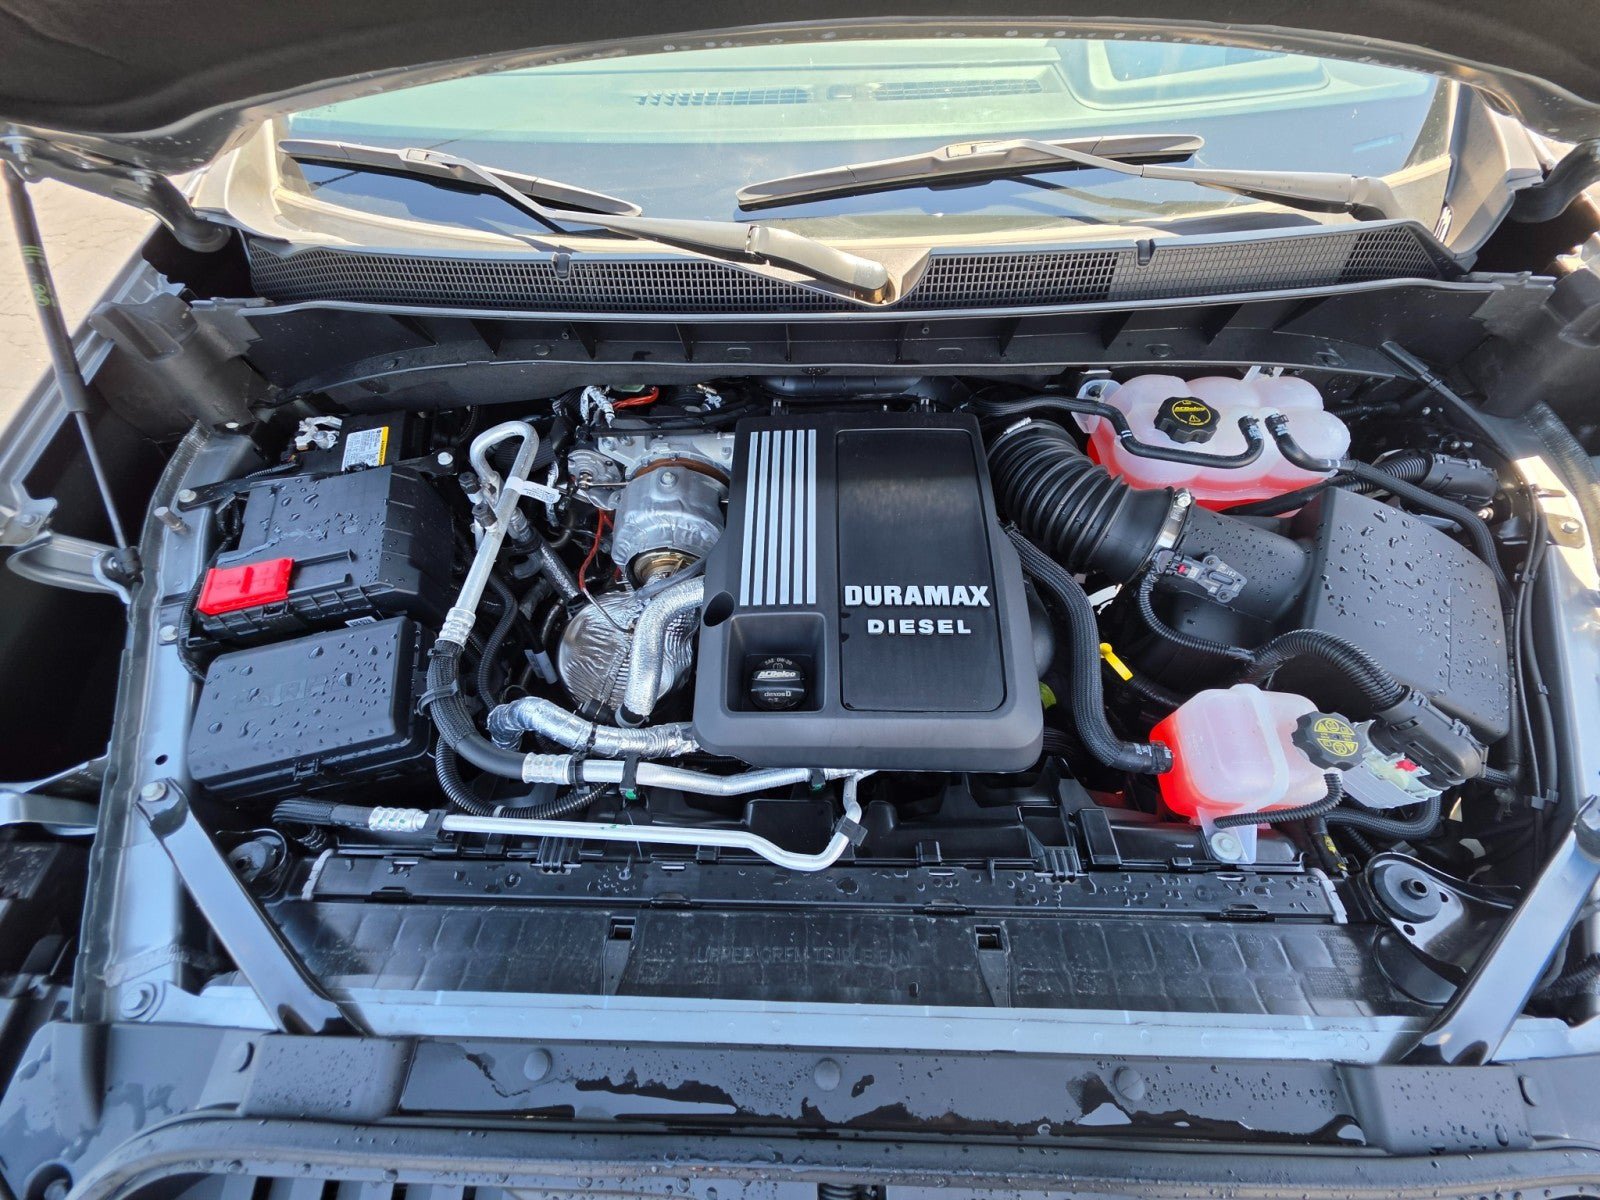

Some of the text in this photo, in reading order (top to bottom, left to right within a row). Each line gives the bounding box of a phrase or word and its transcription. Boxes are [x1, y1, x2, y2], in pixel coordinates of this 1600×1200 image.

[844, 585, 991, 607] DURAMAX
[867, 619, 972, 635] DIESEL
[757, 670, 796, 679] ACDelco
[697, 946, 754, 964] UPPER
[879, 948, 911, 966] FAN
